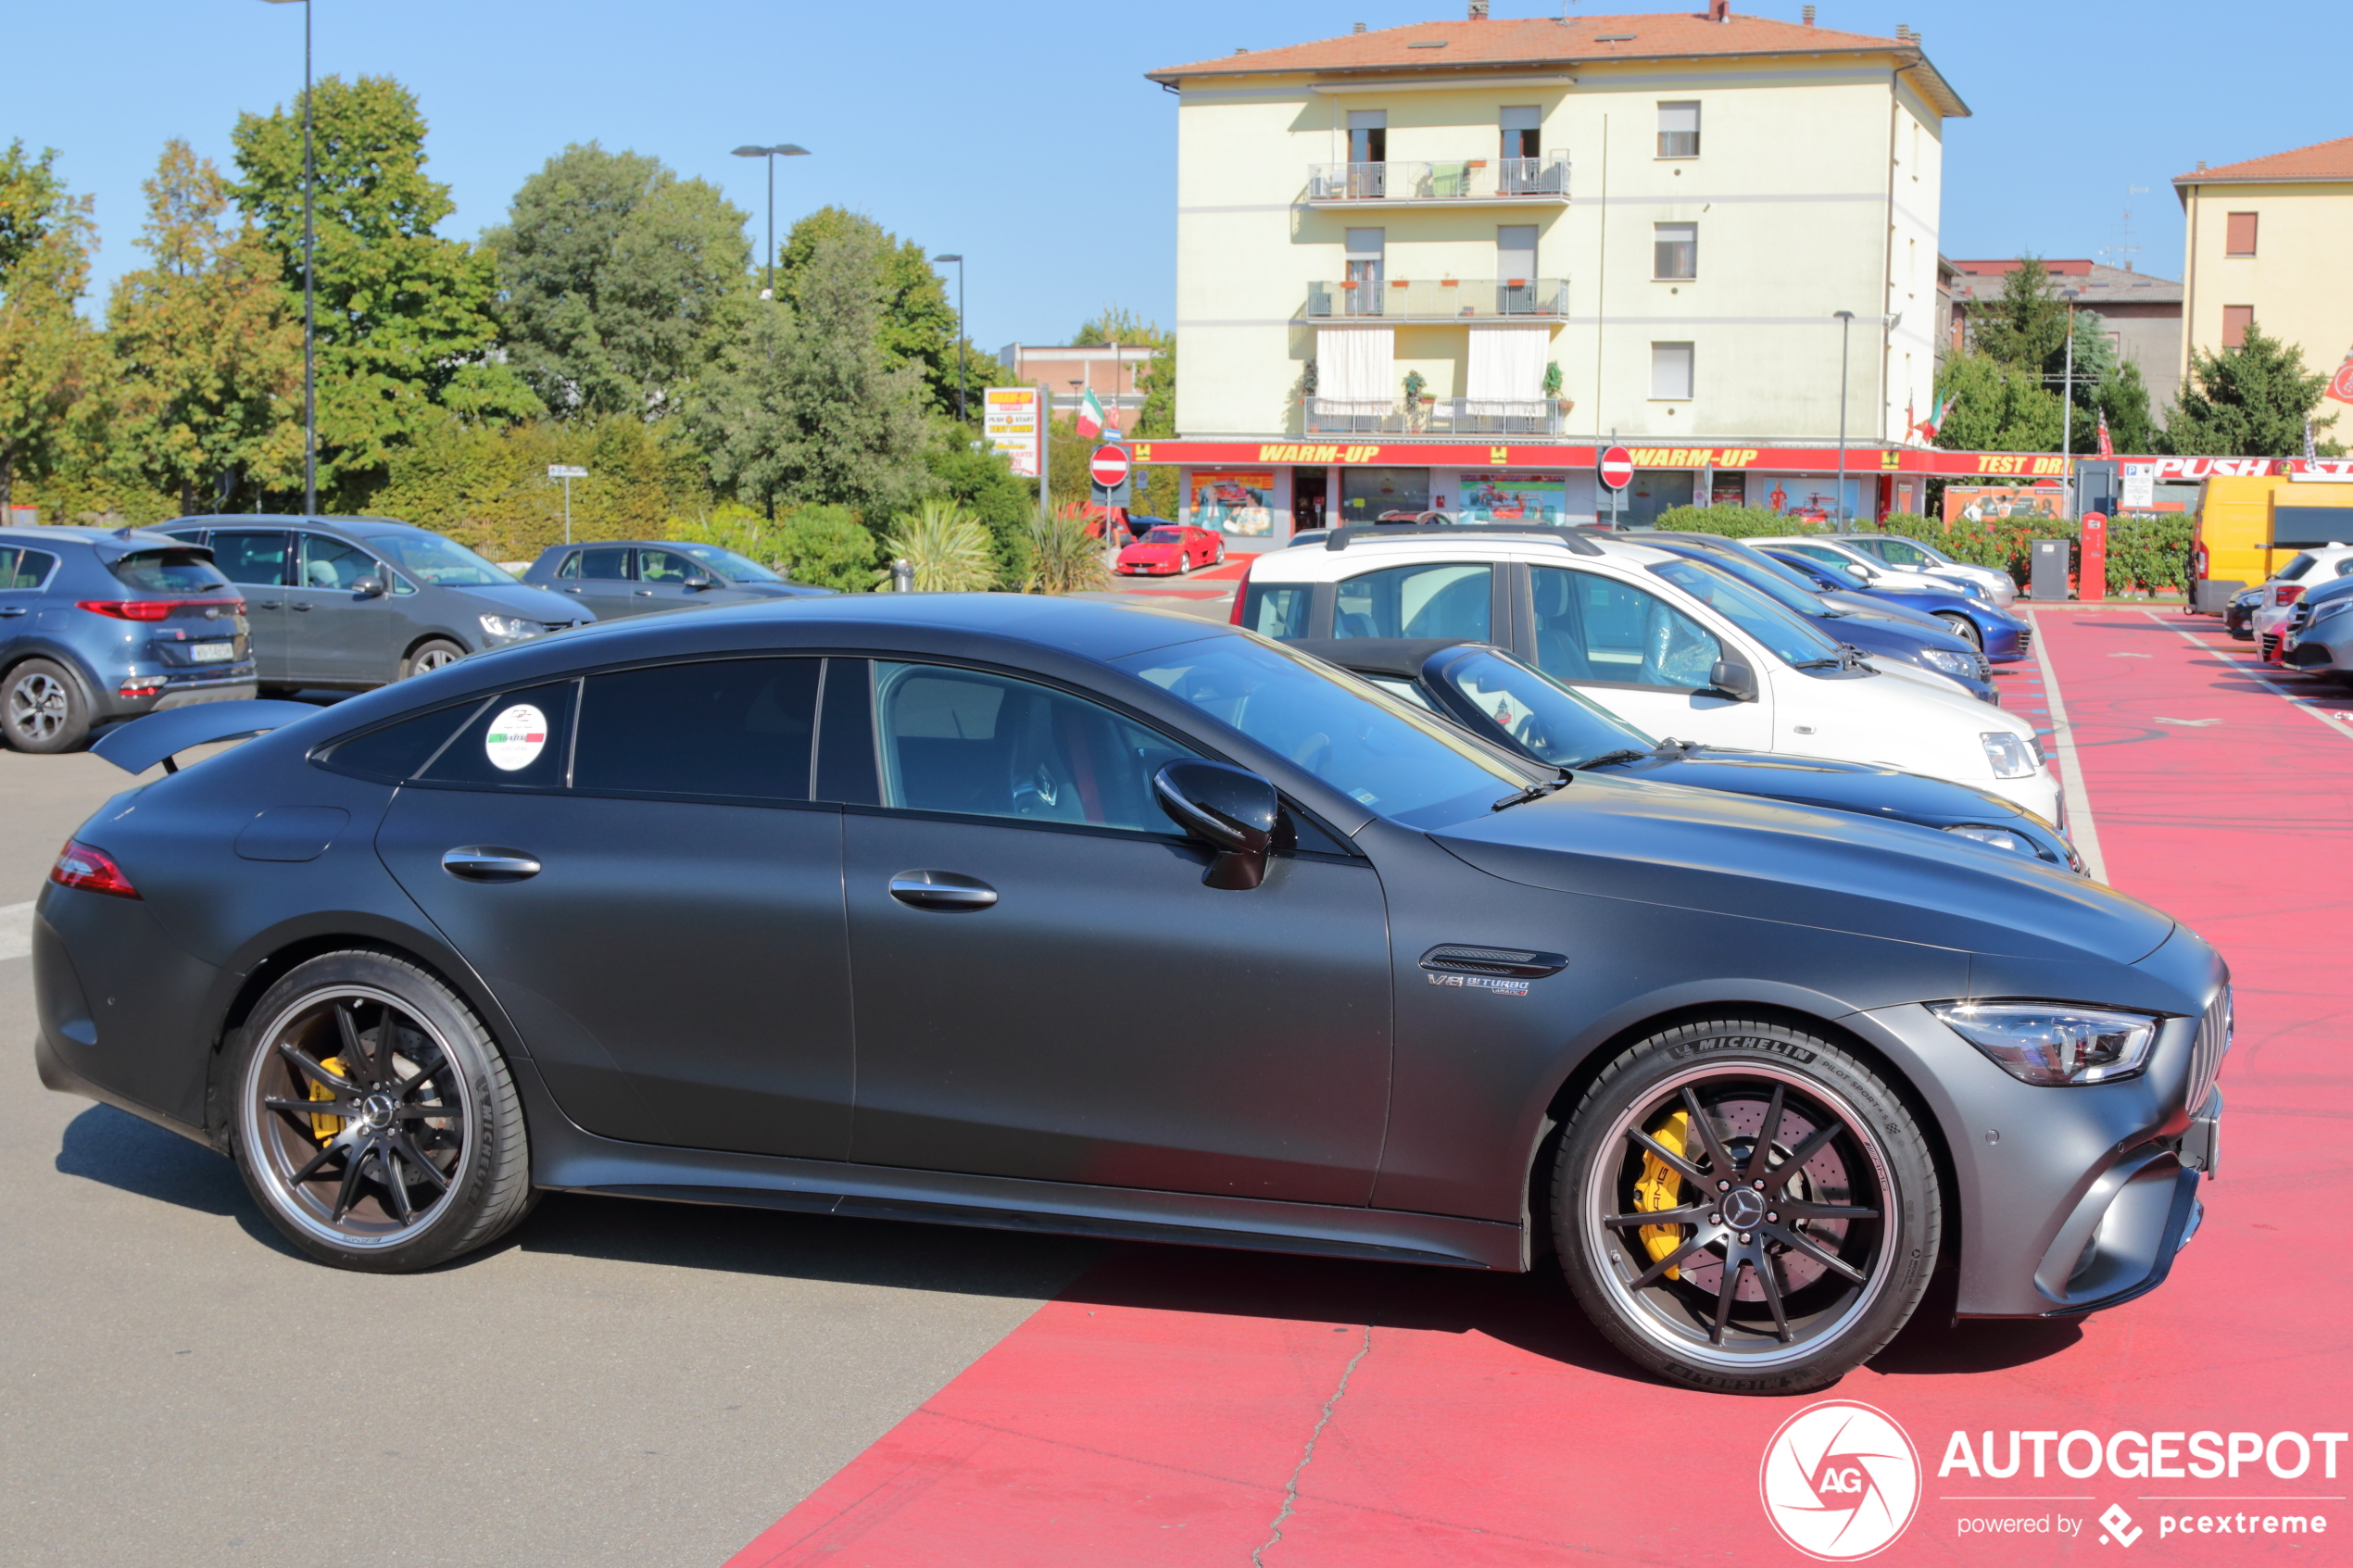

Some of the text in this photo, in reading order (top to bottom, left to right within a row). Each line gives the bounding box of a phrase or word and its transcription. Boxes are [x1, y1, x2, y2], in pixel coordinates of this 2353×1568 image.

[1258, 445, 1379, 463] WARM-UP
[1629, 448, 1758, 467] WARM-UP
[1978, 456, 2027, 473] TEST
[2154, 458, 2271, 477] PUSH
[1428, 974, 1529, 989] V8 BITURBO
[1699, 1036, 1812, 1060] MICHELIN
[1821, 1060, 1851, 1081] PILOT
[1850, 1081, 1879, 1109] SPORT
[1653, 1166, 1669, 1210] AMG
[1672, 1364, 1781, 1390] MICHELIN
